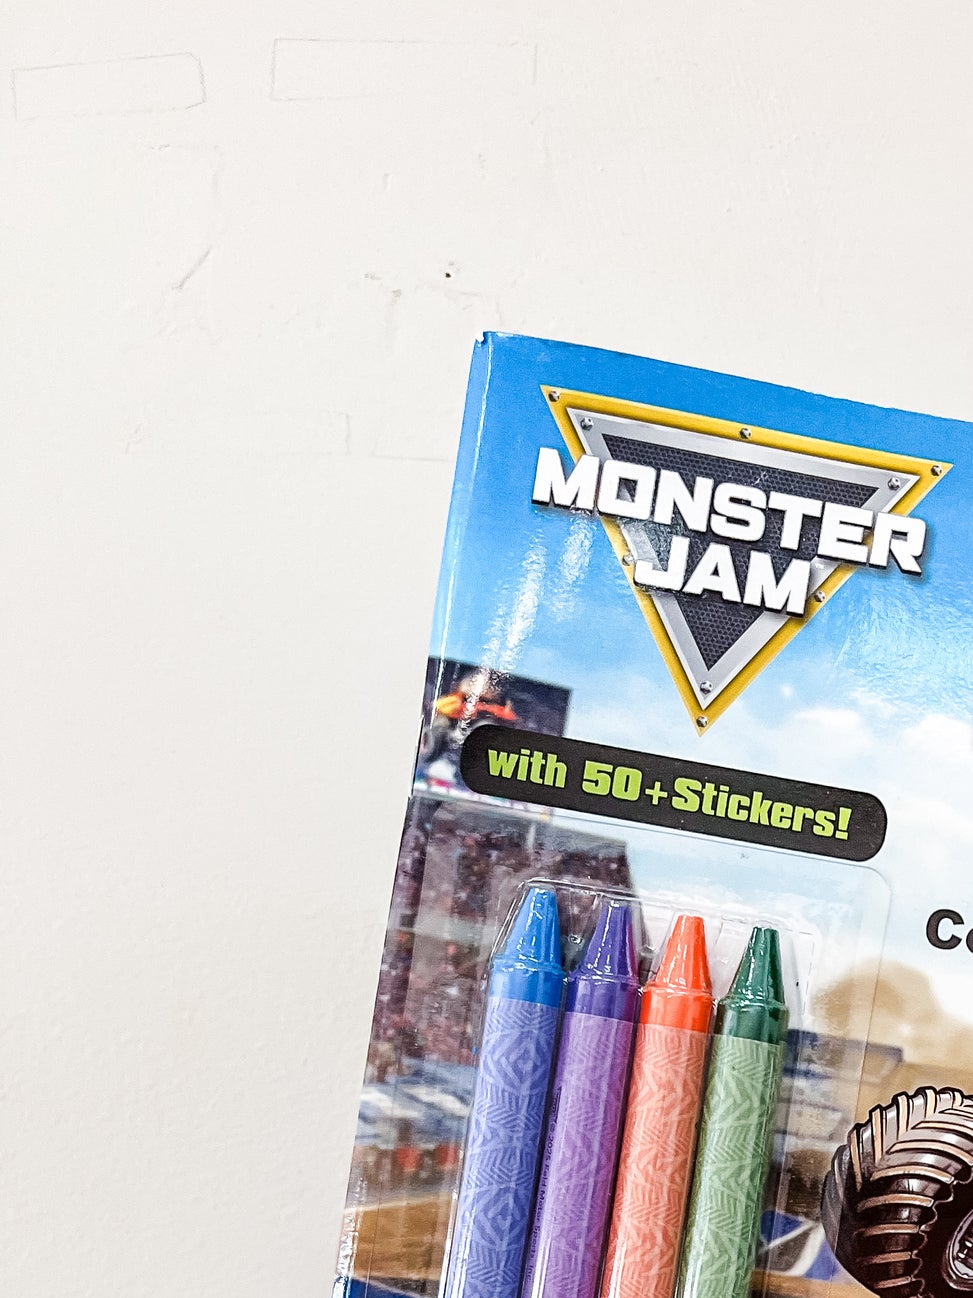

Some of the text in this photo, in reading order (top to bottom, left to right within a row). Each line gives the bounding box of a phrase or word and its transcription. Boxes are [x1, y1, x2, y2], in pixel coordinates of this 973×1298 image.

[533, 447, 927, 576] MONSTER
[633, 536, 812, 616] JAM
[487, 745, 567, 788] with
